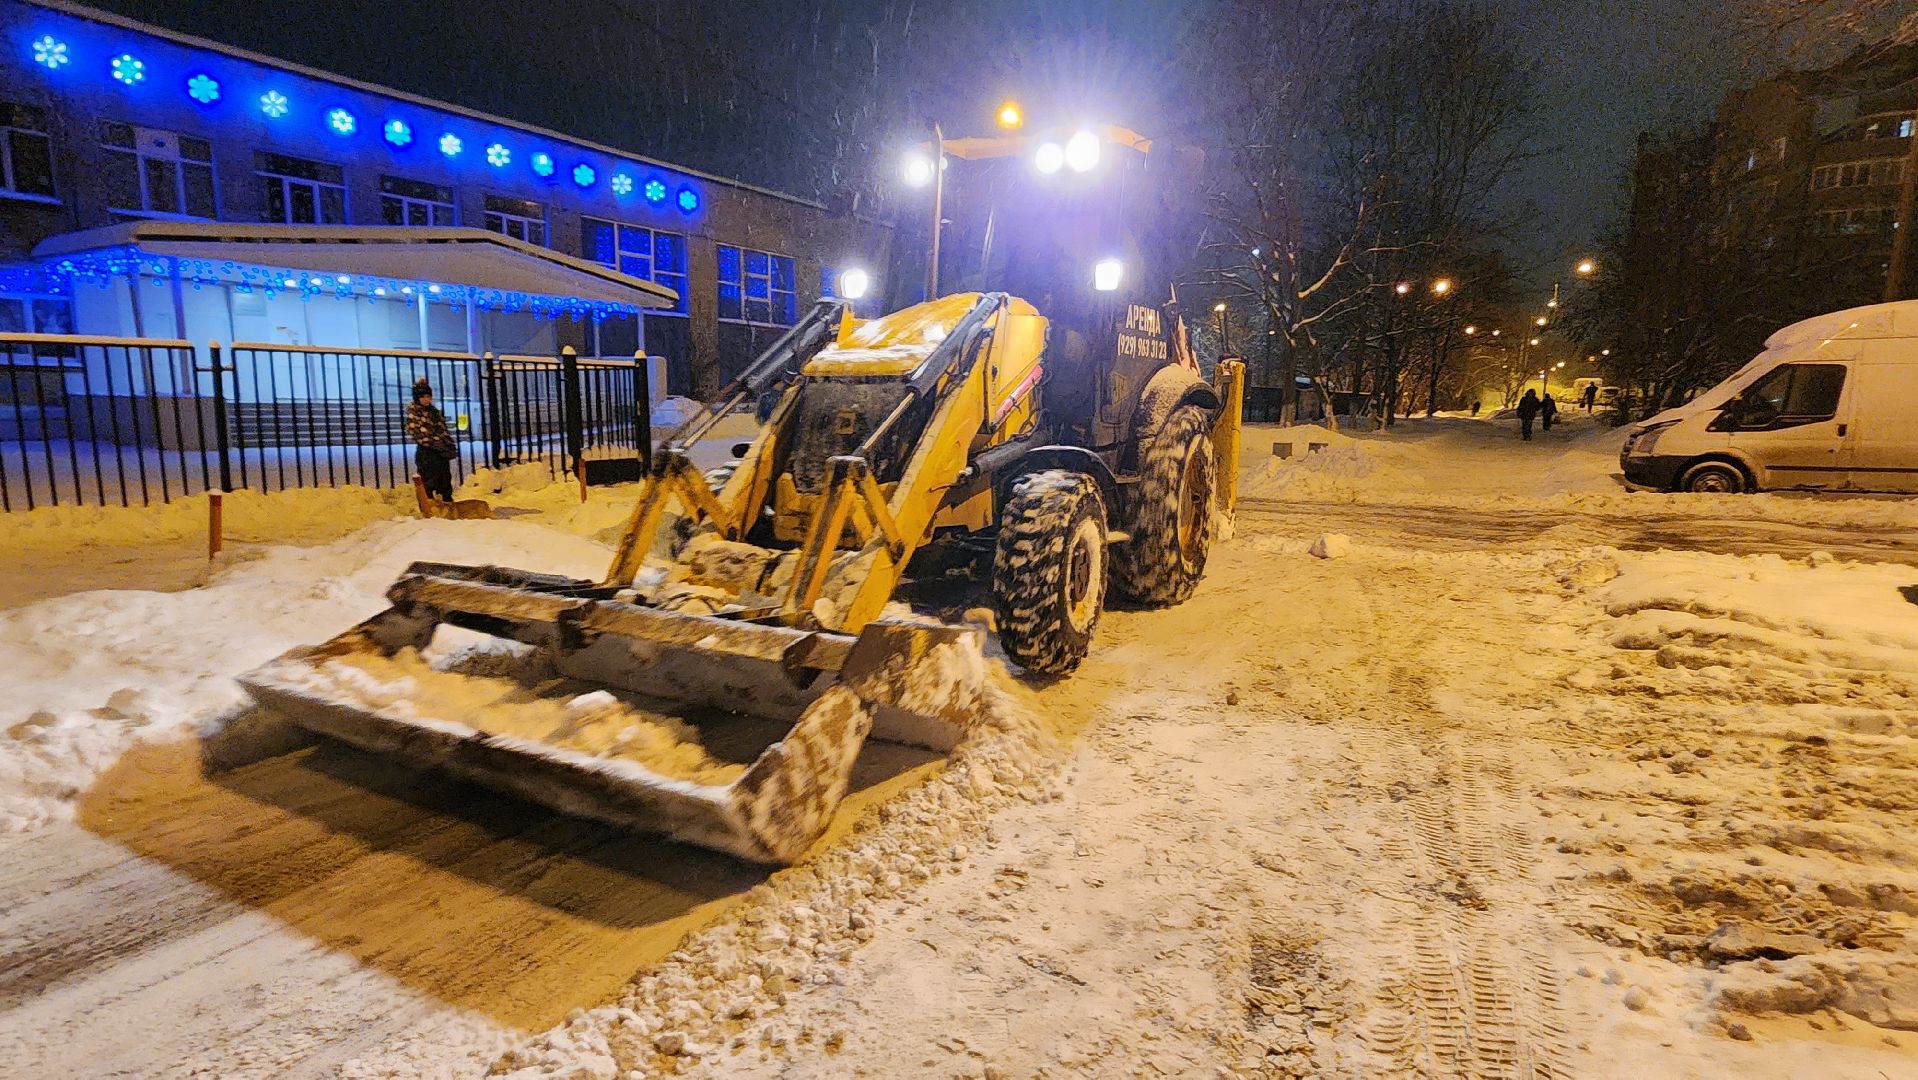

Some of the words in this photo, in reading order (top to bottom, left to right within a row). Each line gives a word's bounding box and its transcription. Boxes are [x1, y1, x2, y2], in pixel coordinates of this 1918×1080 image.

[1125, 304, 1161, 337] АРЕНДА
[1117, 332, 1136, 359] (929)
[1137, 337, 1150, 357] 963
